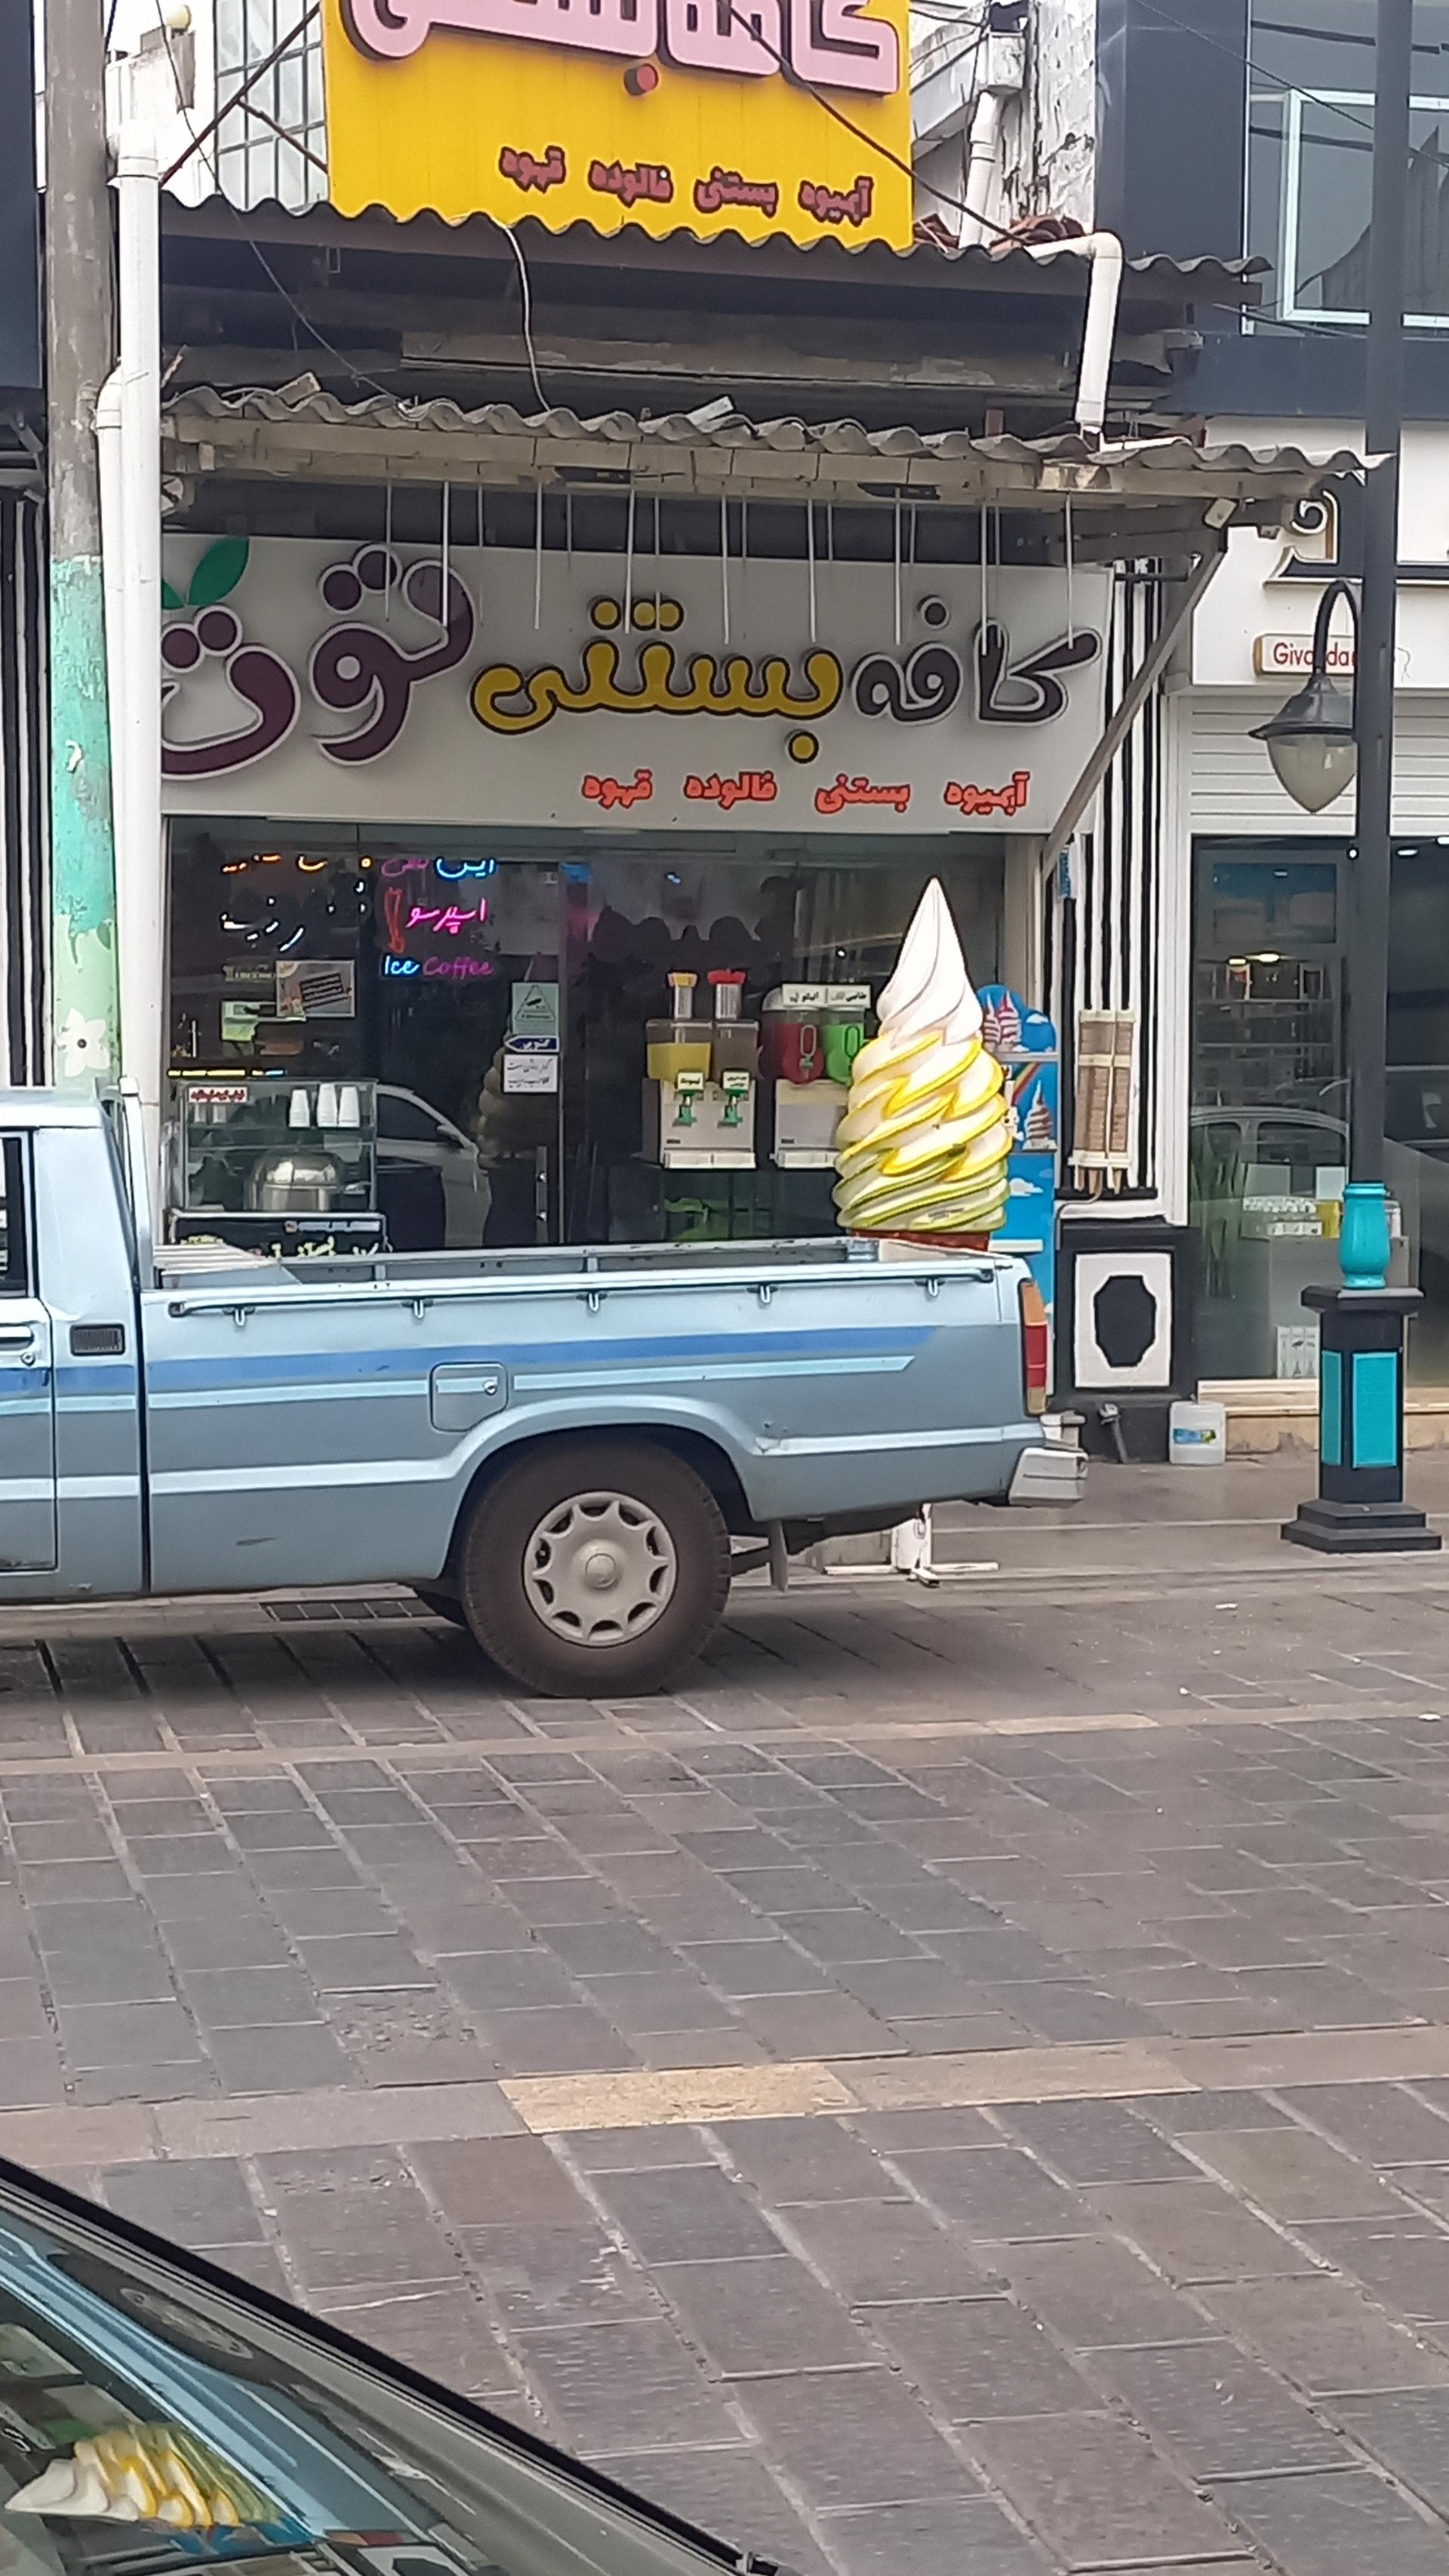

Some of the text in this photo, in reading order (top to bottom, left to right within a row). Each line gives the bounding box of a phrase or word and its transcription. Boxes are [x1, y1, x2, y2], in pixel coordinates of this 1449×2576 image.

[499, 146, 565, 194] قهوه
[588, 159, 672, 208] فالوده
[694, 166, 778, 217] بستنی
[471, 595, 843, 764] بستنی
[851, 595, 1103, 723] کافه
[582, 768, 1030, 816] آبمیوه بستنی فالوده قهوه
[384, 956, 494, 980] Ice Coffee
